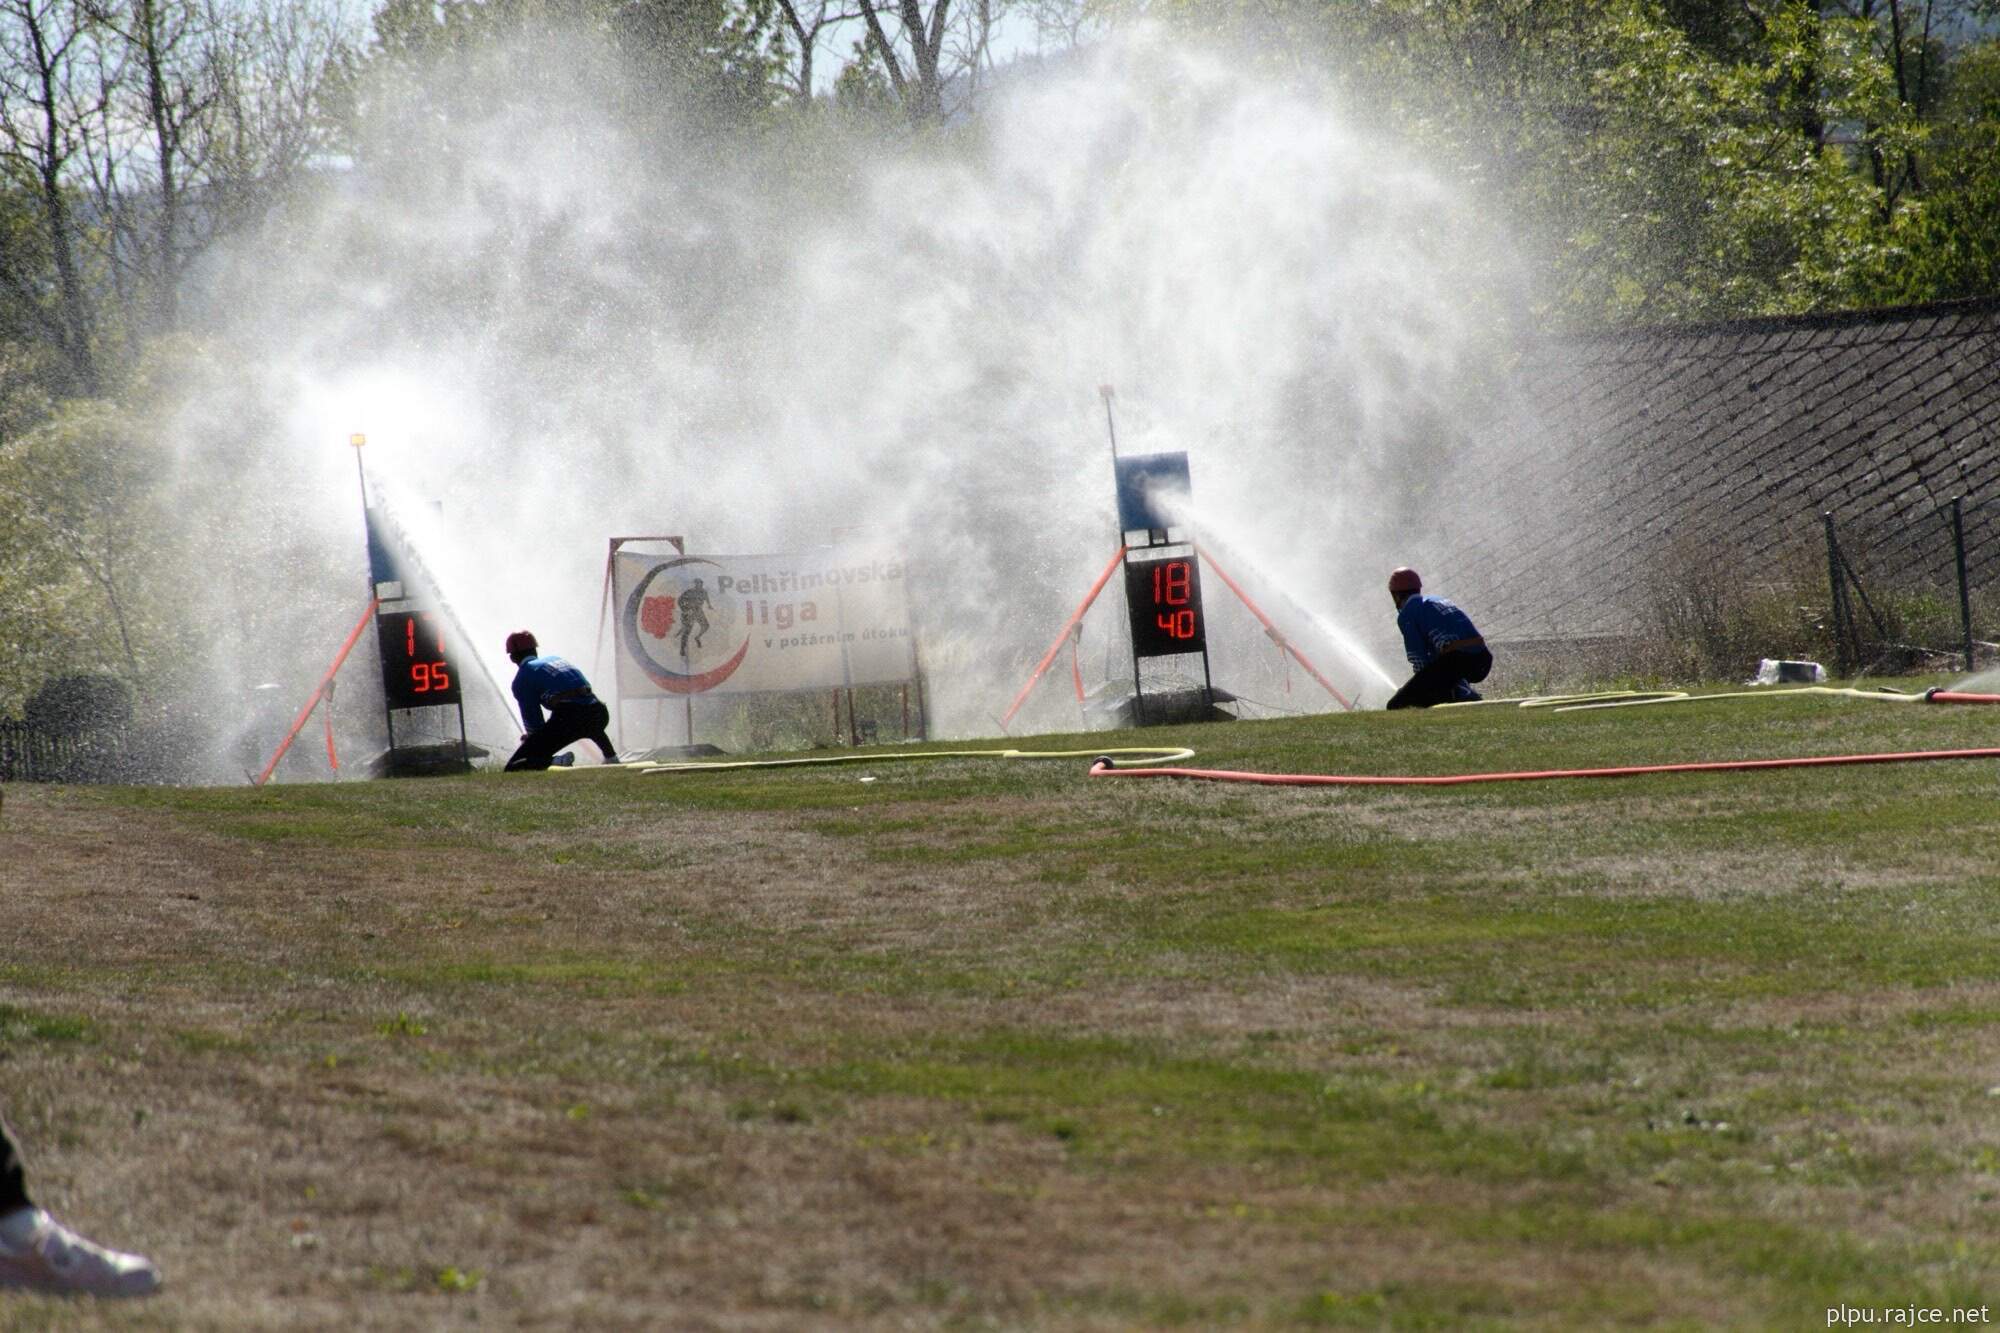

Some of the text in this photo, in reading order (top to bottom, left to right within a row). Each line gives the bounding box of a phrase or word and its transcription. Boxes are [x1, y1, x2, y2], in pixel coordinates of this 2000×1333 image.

[717, 557, 904, 595] Pelhřimovská
[1154, 562, 1191, 604] 18
[745, 599, 818, 630] liga
[1158, 610, 1194, 639] 40
[764, 639, 773, 648] v
[779, 630, 856, 650] požárním
[411, 662, 449, 693] 95
